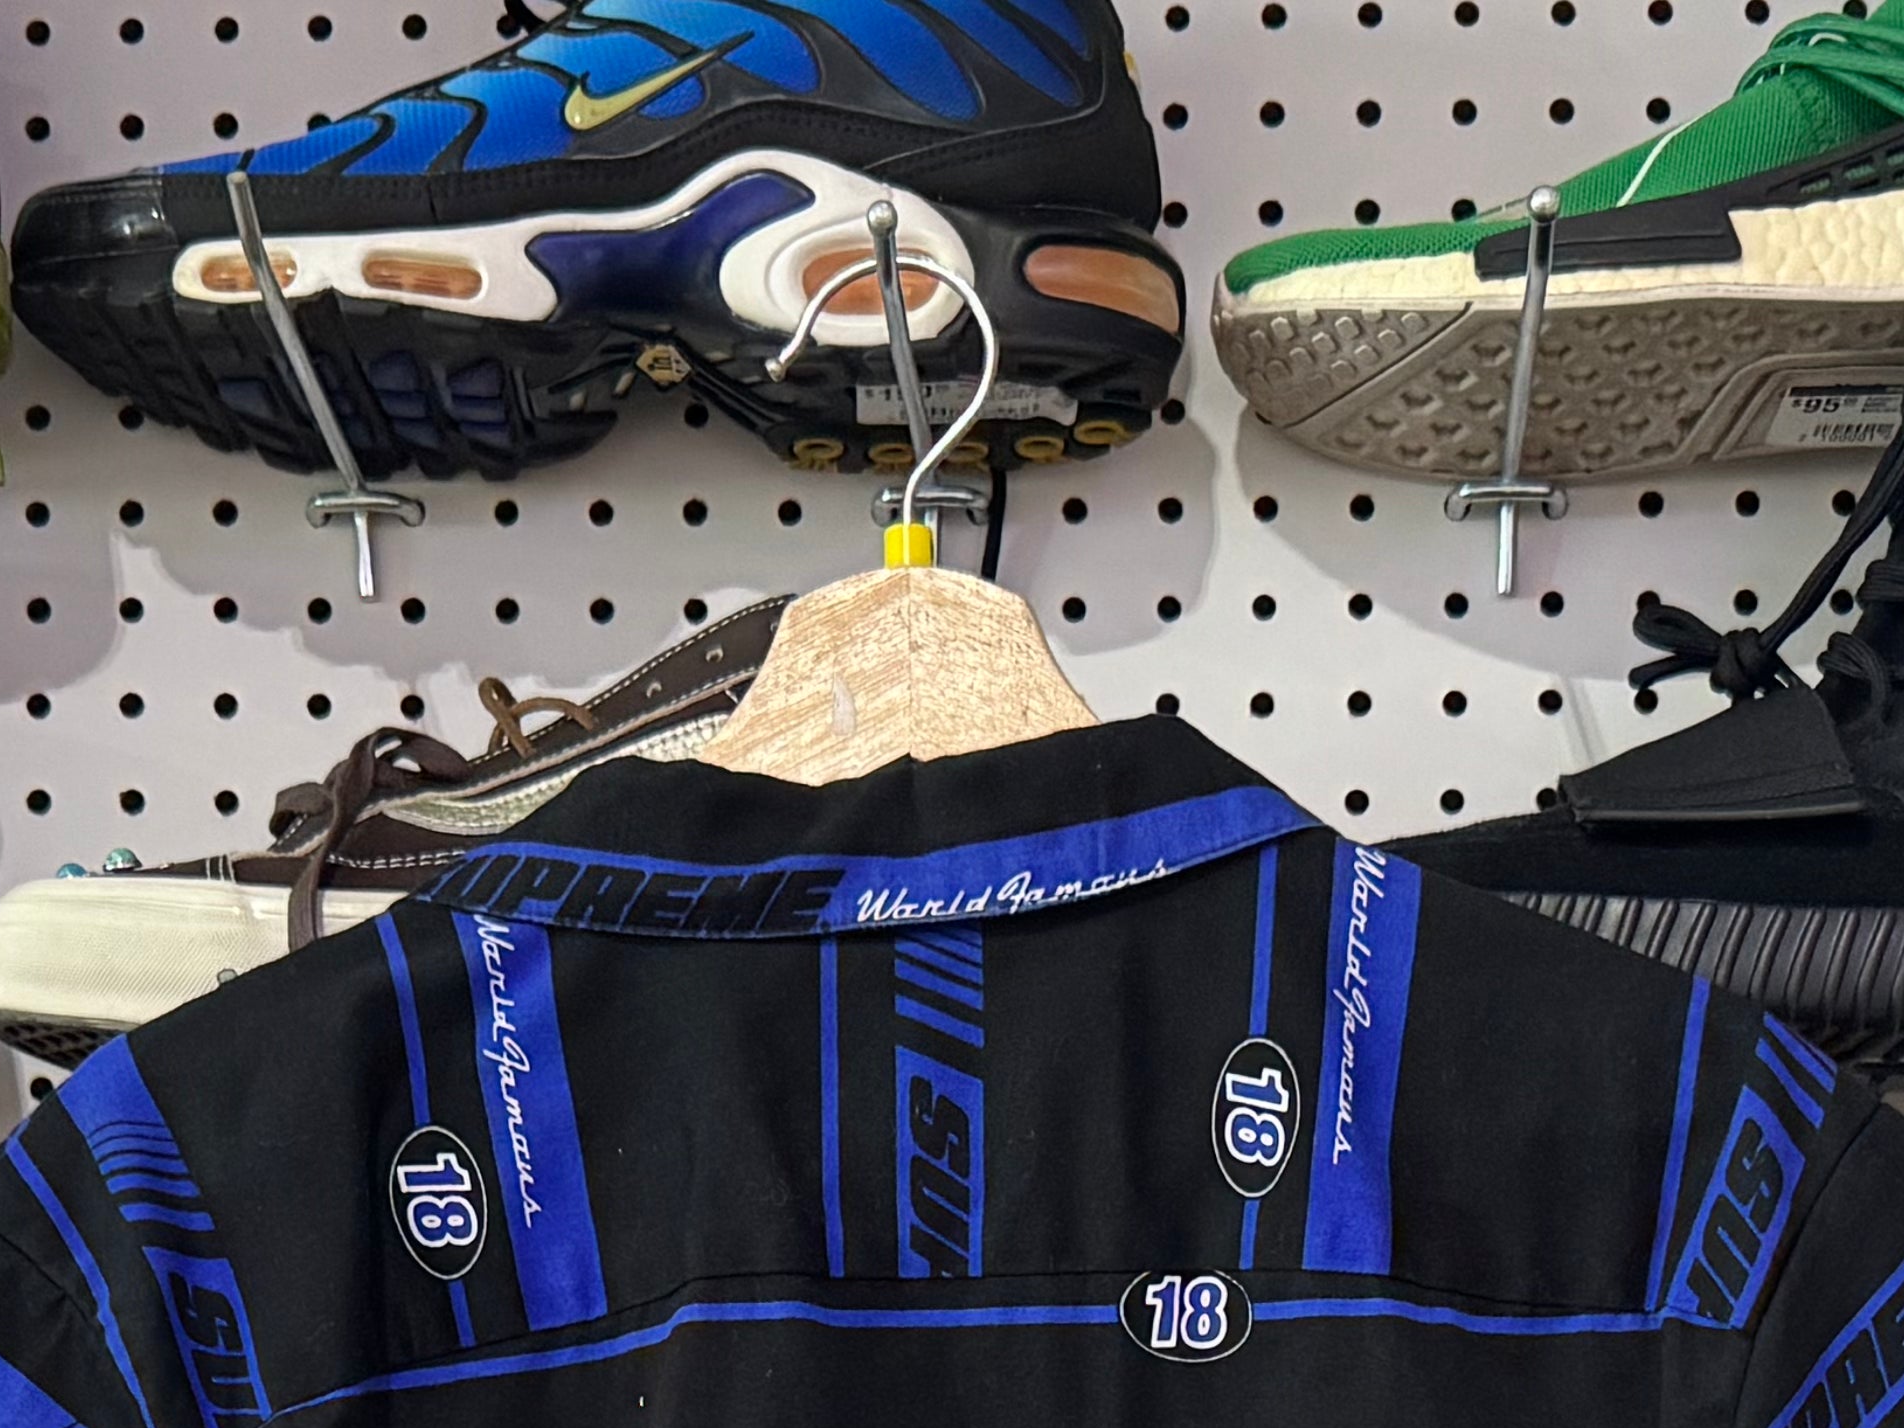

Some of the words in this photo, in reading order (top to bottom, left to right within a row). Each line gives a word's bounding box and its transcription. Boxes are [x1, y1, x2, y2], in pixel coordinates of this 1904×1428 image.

[856, 884, 986, 923] World
[1225, 1066, 1290, 1166] 18
[396, 1151, 474, 1248] 18
[1147, 1275, 1229, 1348] 18
